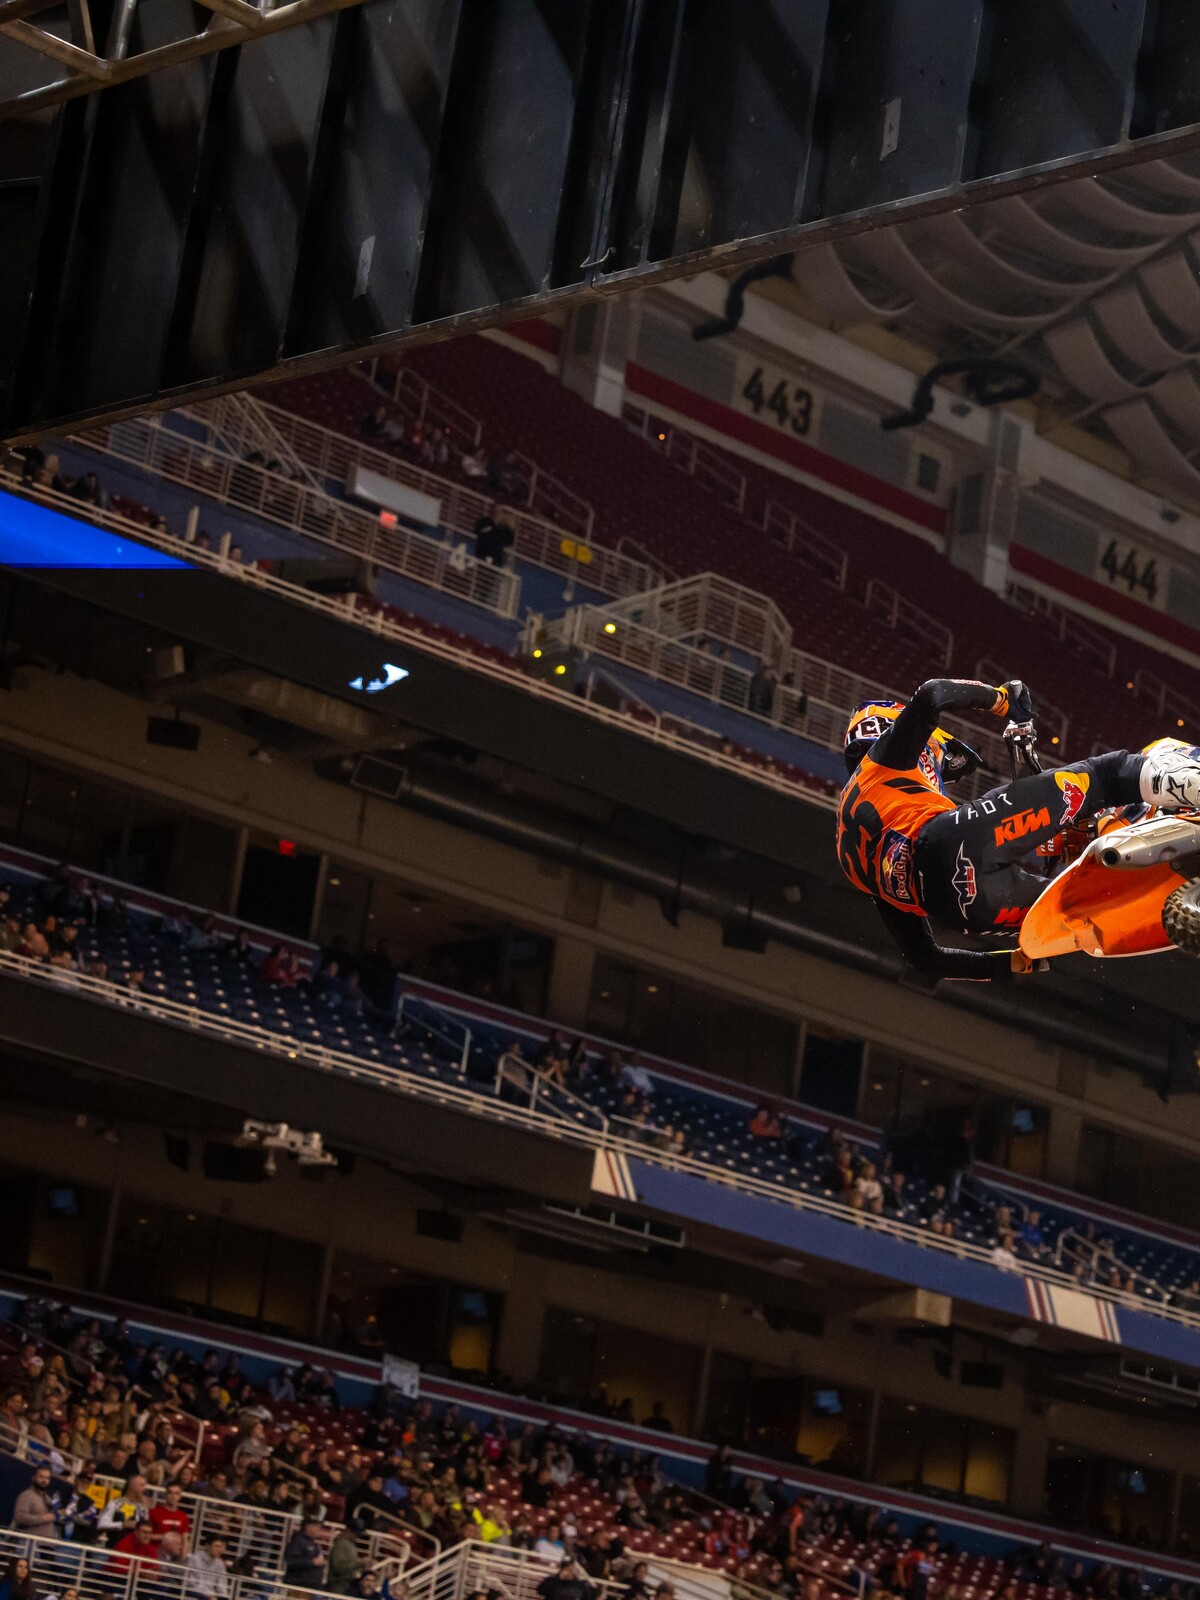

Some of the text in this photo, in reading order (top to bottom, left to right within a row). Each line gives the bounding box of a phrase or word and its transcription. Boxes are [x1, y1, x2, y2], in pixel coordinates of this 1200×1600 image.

[743, 367, 813, 436] 443
[1101, 540, 1157, 600] 444
[993, 806, 1051, 847] KTM
